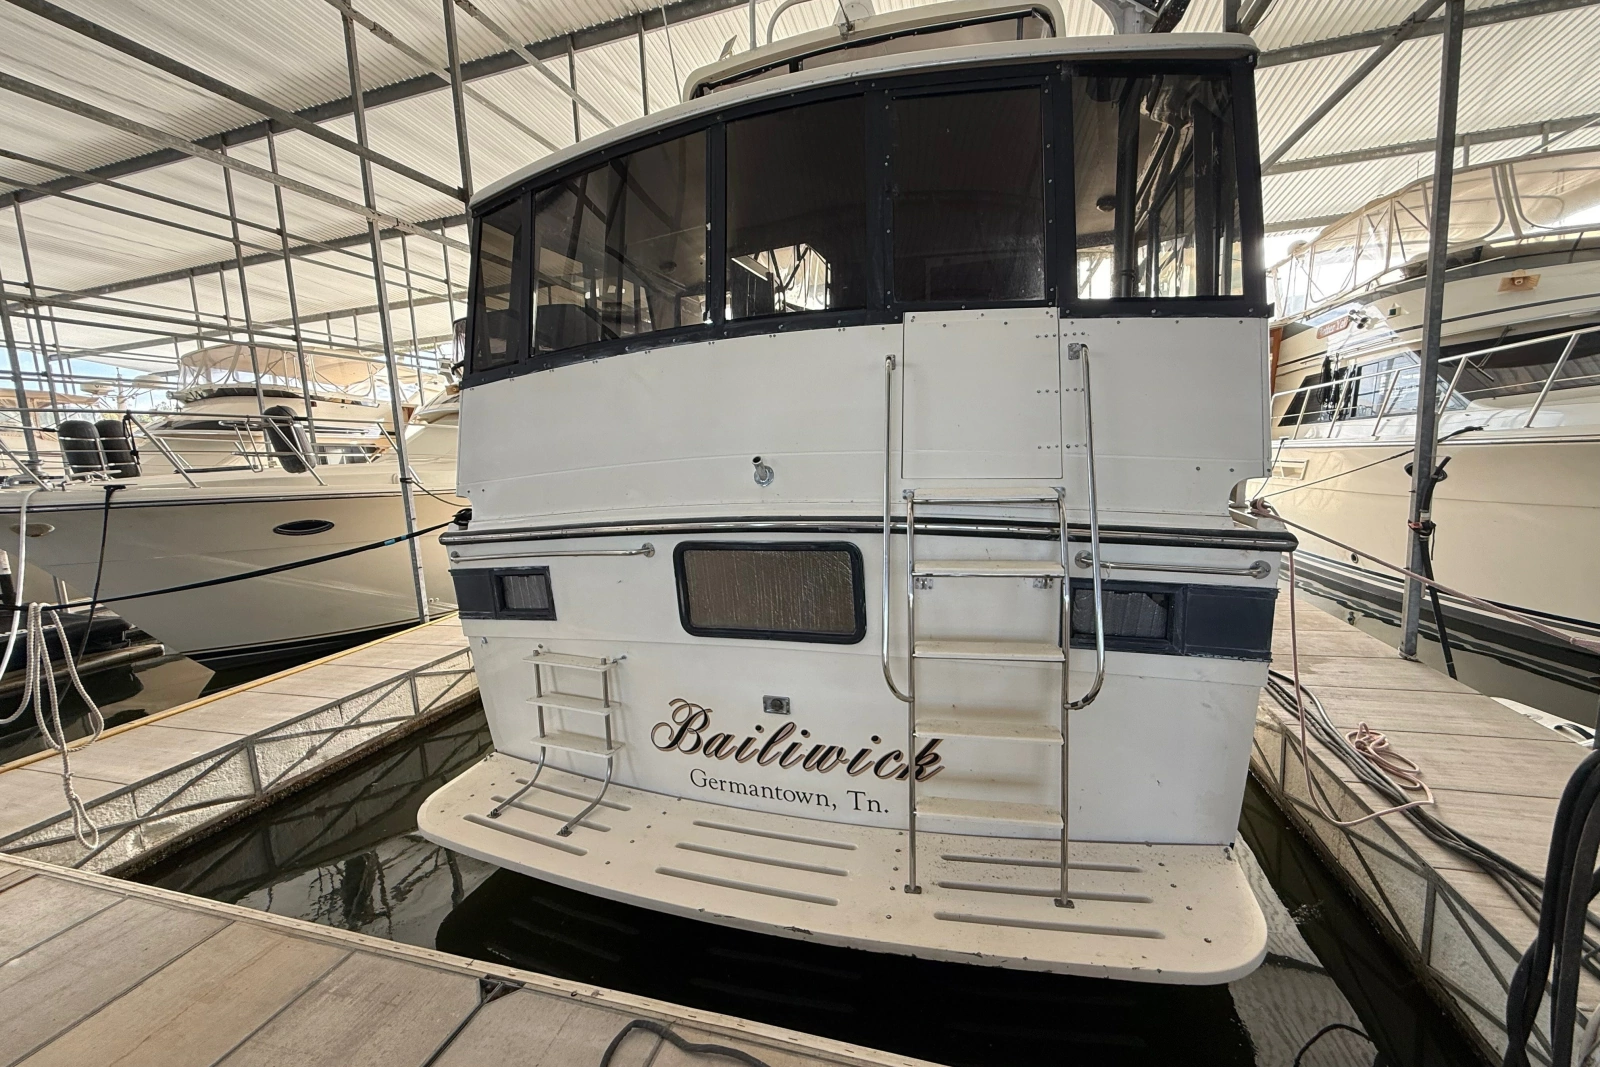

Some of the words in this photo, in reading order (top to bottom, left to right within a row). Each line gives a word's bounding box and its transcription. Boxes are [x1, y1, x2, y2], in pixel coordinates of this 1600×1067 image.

[651, 698, 945, 782] Bailiwick
[690, 768, 837, 811] Germantown,
[847, 790, 889, 813] Tn.
